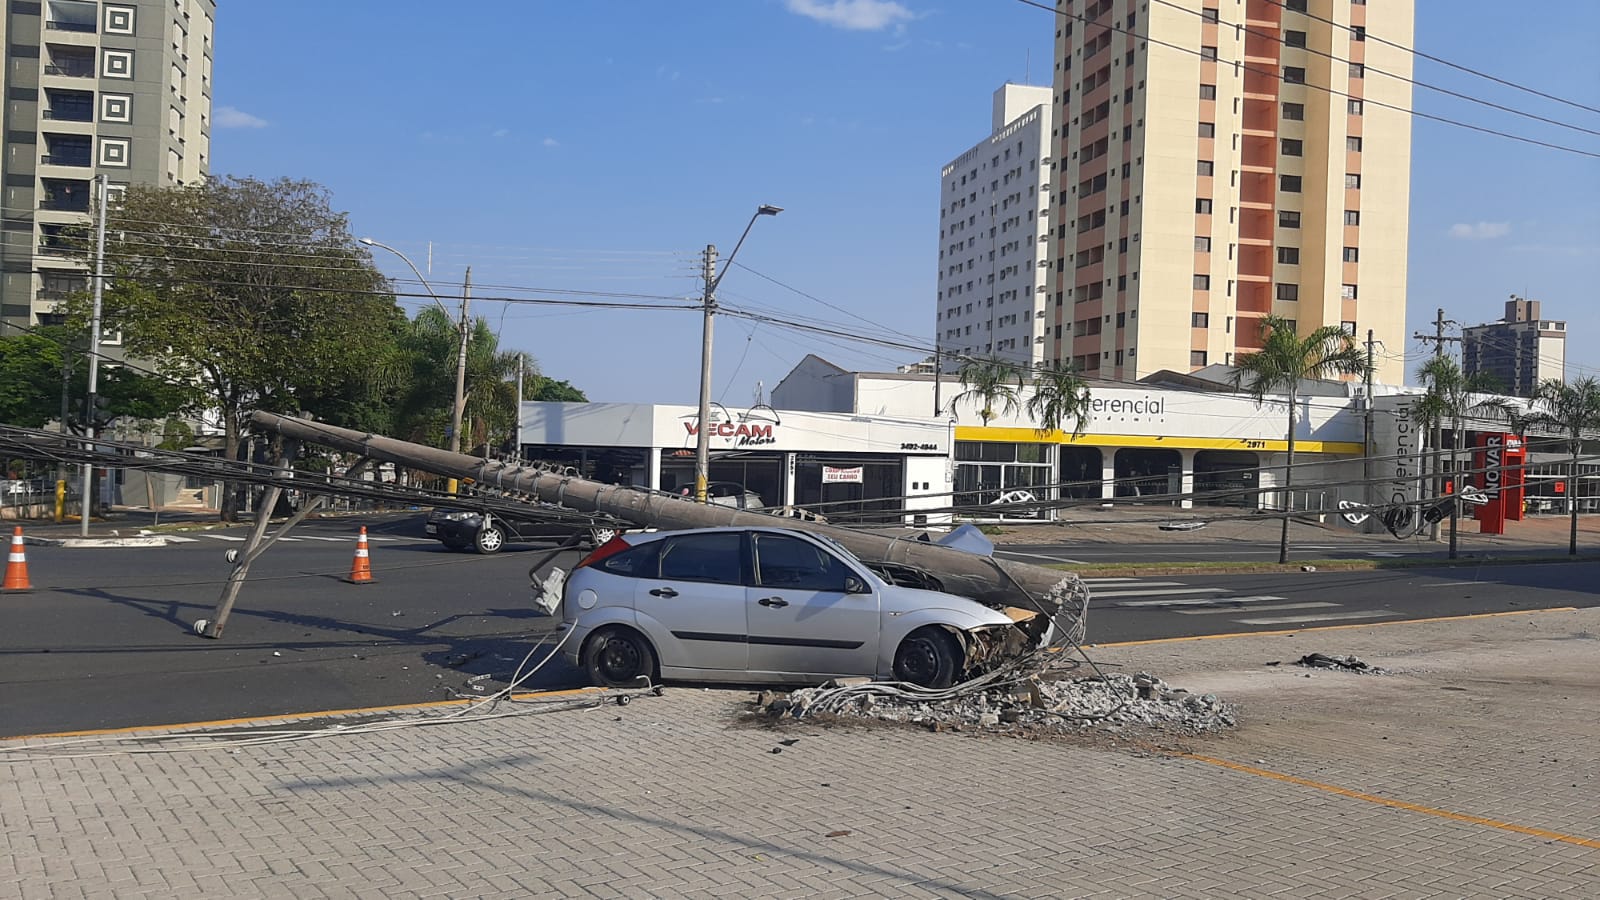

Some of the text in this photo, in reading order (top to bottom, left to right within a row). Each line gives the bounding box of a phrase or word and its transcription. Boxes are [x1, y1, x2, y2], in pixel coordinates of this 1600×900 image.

[1086, 395, 1164, 414] ferencial
[684, 421, 772, 437] VECAM
[738, 436, 776, 447] Motors
[1486, 436, 1501, 499] INOVAR
